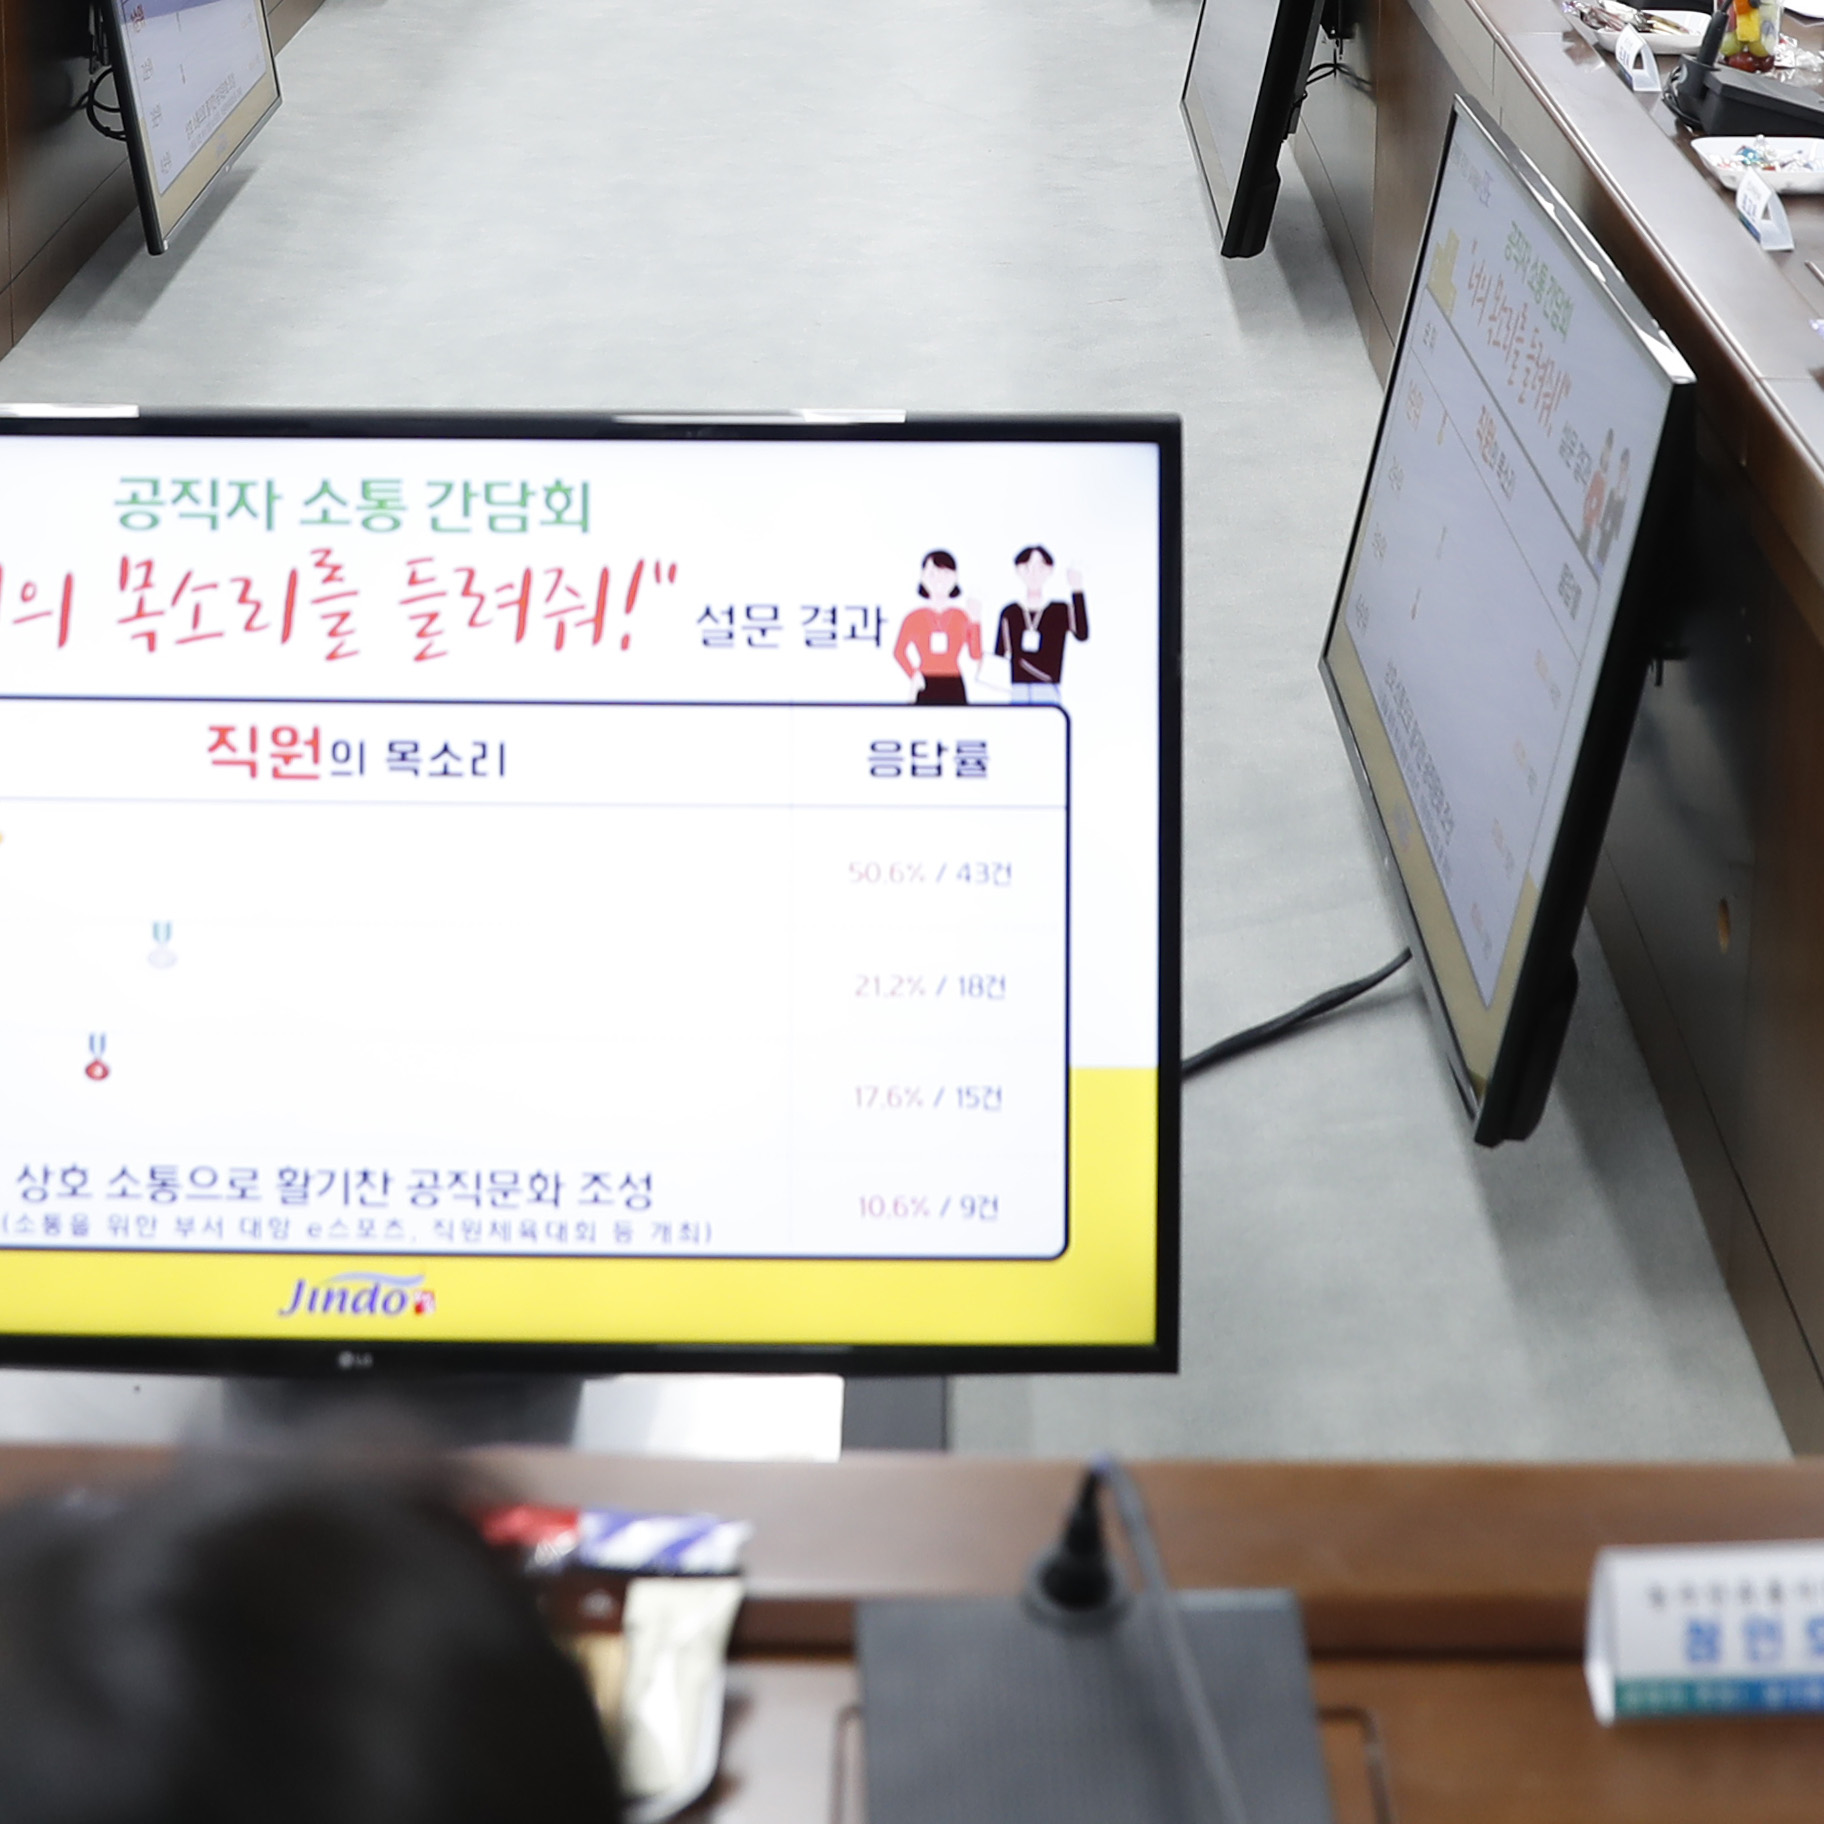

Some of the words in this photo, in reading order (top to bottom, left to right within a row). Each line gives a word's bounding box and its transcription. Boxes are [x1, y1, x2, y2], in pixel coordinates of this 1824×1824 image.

[114, 477, 282, 532] 공직자
[300, 477, 409, 534] 소통
[426, 477, 593, 534] 간담회
[117, 546, 360, 662] 목소리를
[399, 557, 678, 662] 들려줘!"
[697, 604, 783, 648] 설문
[800, 604, 888, 648] 결과
[206, 725, 366, 780] 직원의
[385, 739, 507, 779] 목소리
[867, 739, 990, 778] 응답률
[17, 1163, 94, 1204] 상호
[105, 1164, 263, 1205] 소통으로
[276, 1165, 393, 1207] 활기찬
[407, 1167, 567, 1210] 공직문화
[578, 1170, 653, 1211] 조성
[277, 1278, 410, 1317] Jindo
